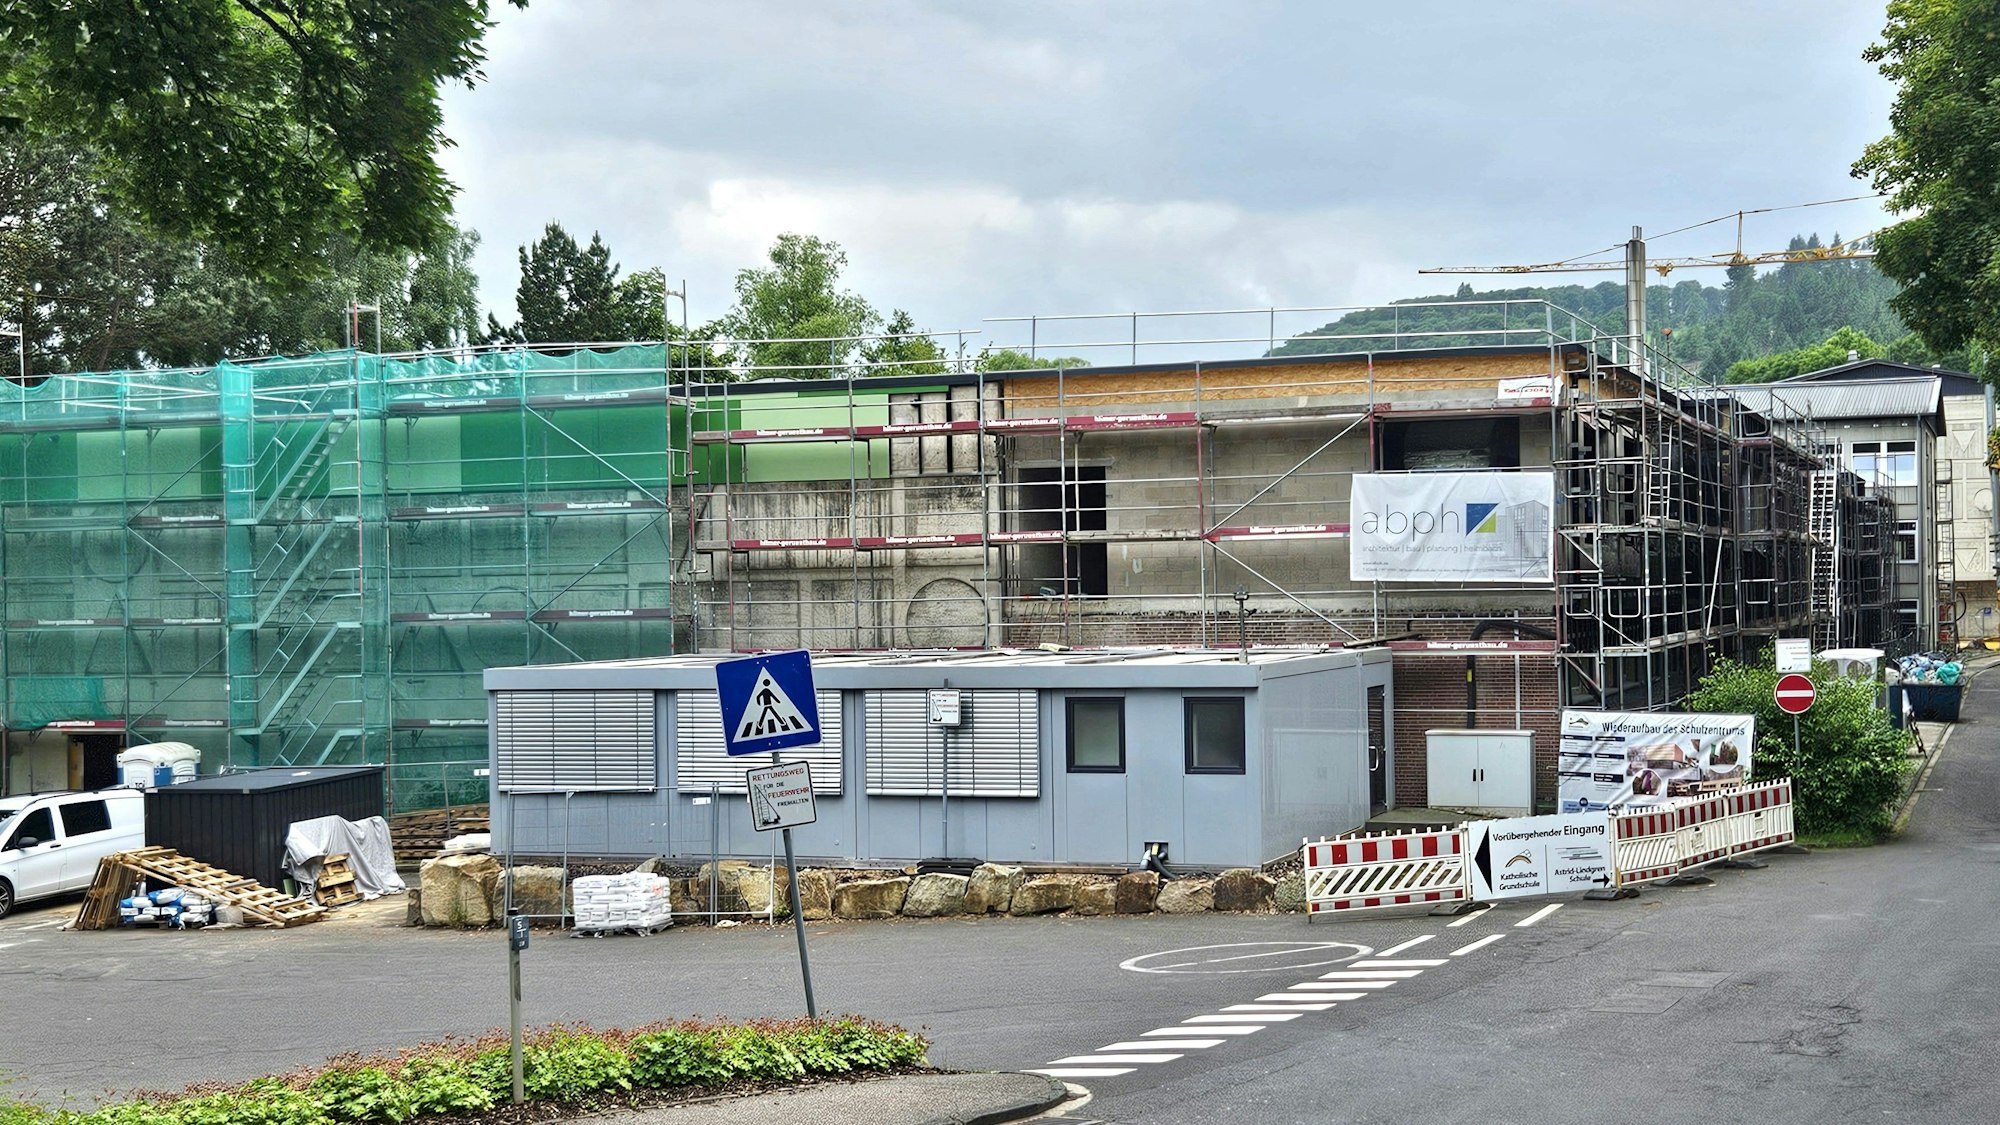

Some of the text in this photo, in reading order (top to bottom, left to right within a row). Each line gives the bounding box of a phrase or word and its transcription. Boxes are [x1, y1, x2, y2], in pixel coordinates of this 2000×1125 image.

[1361, 503, 1460, 542] abph
[1602, 722, 1745, 736] Wiederaufbau des Schulzentrums
[752, 767, 805, 781] RETTUNGSWEG
[767, 787, 810, 799] FEUERWEHR
[1492, 825, 1605, 841] Vorübergehender Eingang
[1500, 871, 1538, 881] Katholische
[1554, 865, 1606, 876] Astrid-Lindgren
[1569, 874, 1591, 883] Schule
[1499, 881, 1540, 891] Grundschule
